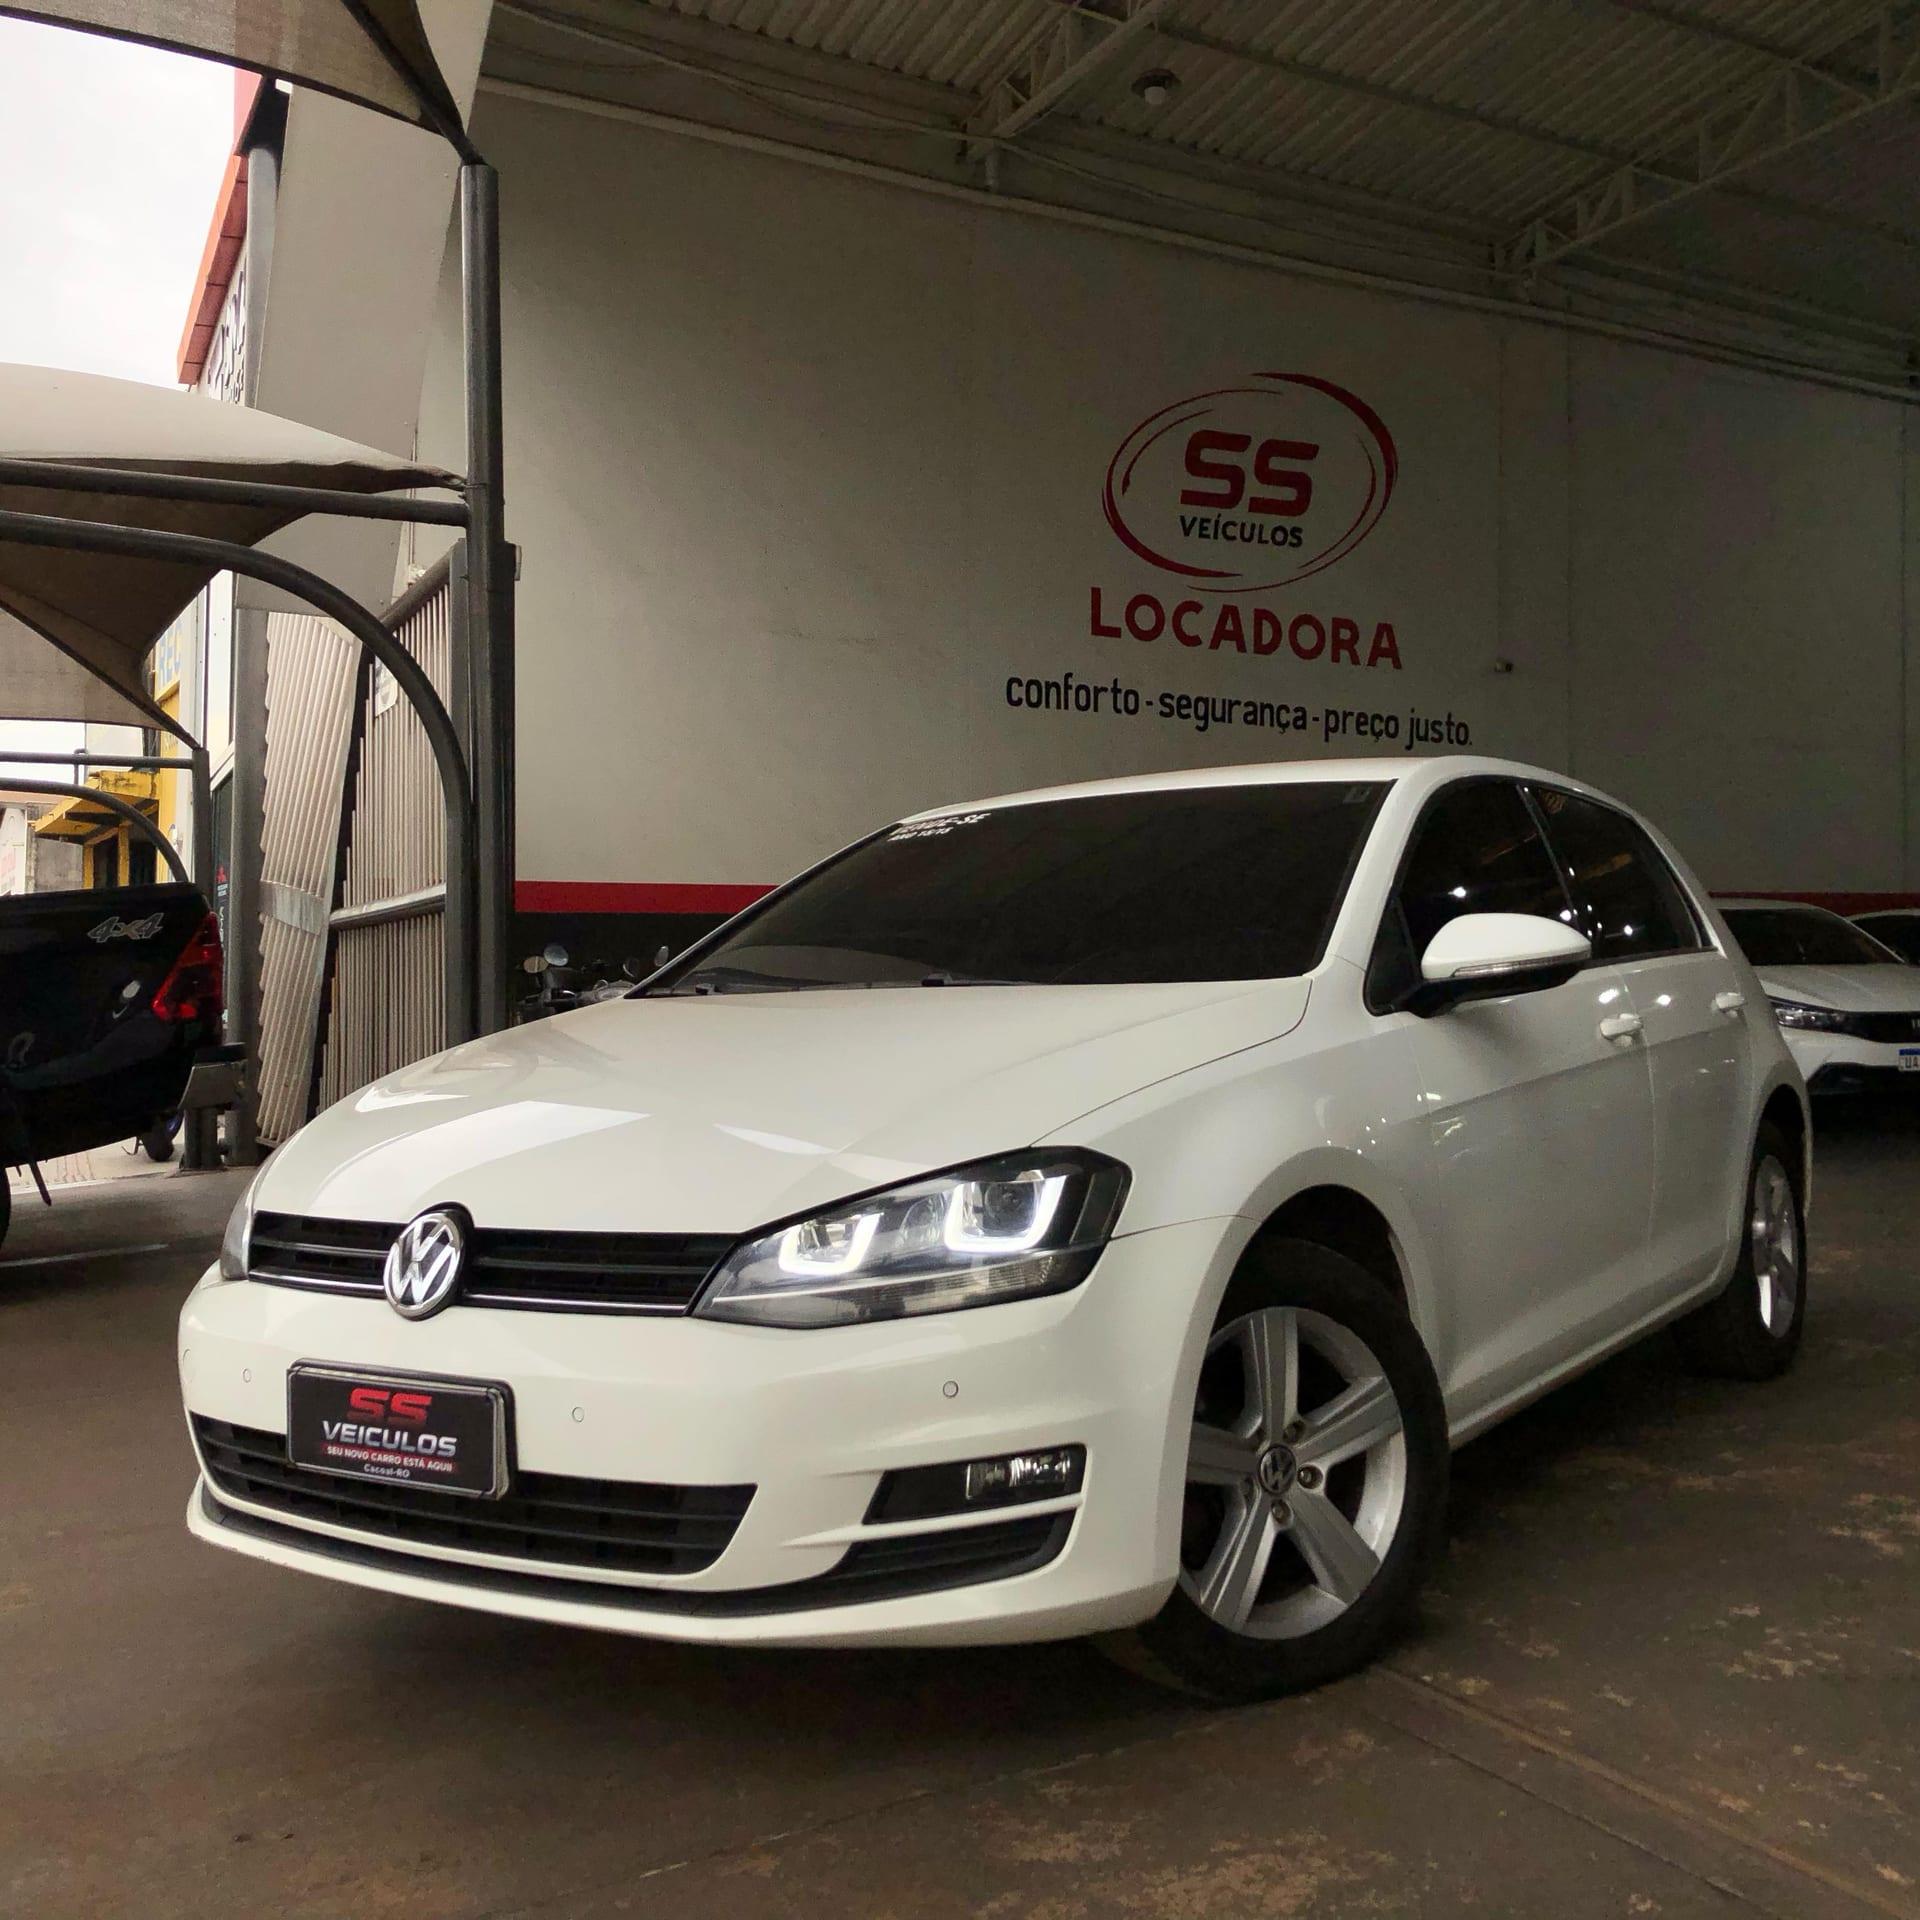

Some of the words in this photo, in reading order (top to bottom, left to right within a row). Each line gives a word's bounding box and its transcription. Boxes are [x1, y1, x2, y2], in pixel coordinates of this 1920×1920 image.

[1179, 428, 1320, 518] SS
[1178, 513, 1304, 548] VEÍCULOS
[1090, 586, 1403, 670] LOCADORA
[1005, 671, 1139, 716] conforto
[1158, 692, 1307, 735] segurança
[1324, 707, 1399, 743] preço
[1405, 708, 1473, 750] justo.
[87, 912, 164, 943] 4x4
[348, 1387, 432, 1421] SS
[322, 1420, 457, 1457] VEICULOS
